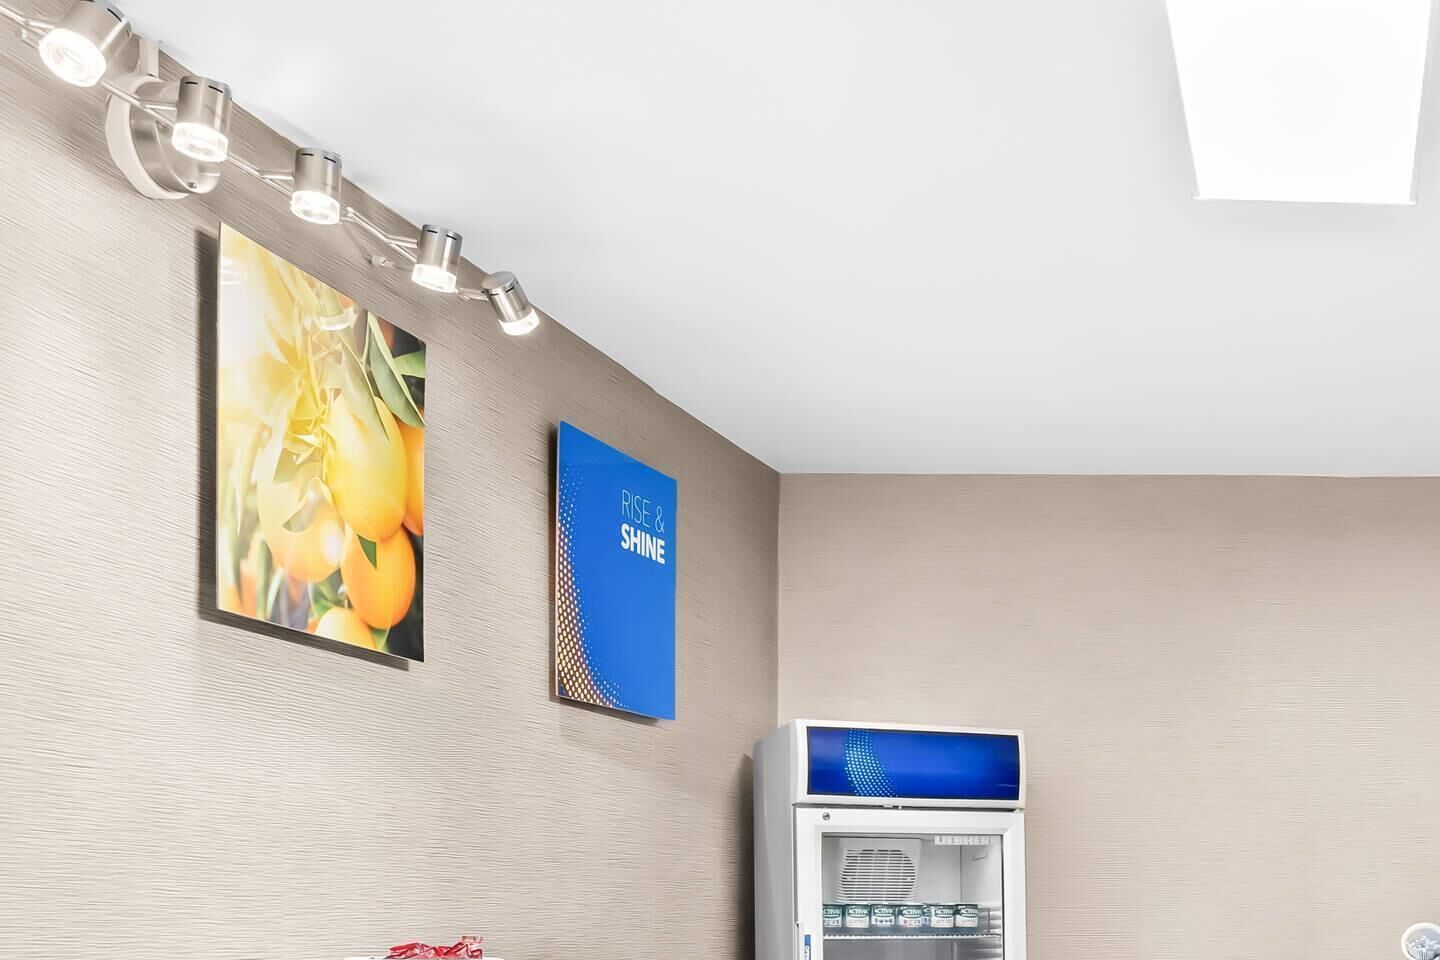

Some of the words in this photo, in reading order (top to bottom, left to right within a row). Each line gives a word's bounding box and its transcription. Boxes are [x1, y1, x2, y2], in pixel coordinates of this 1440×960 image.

[622, 489, 651, 528] RISE
[655, 505, 665, 534] &
[621, 523, 666, 565] SHINE
